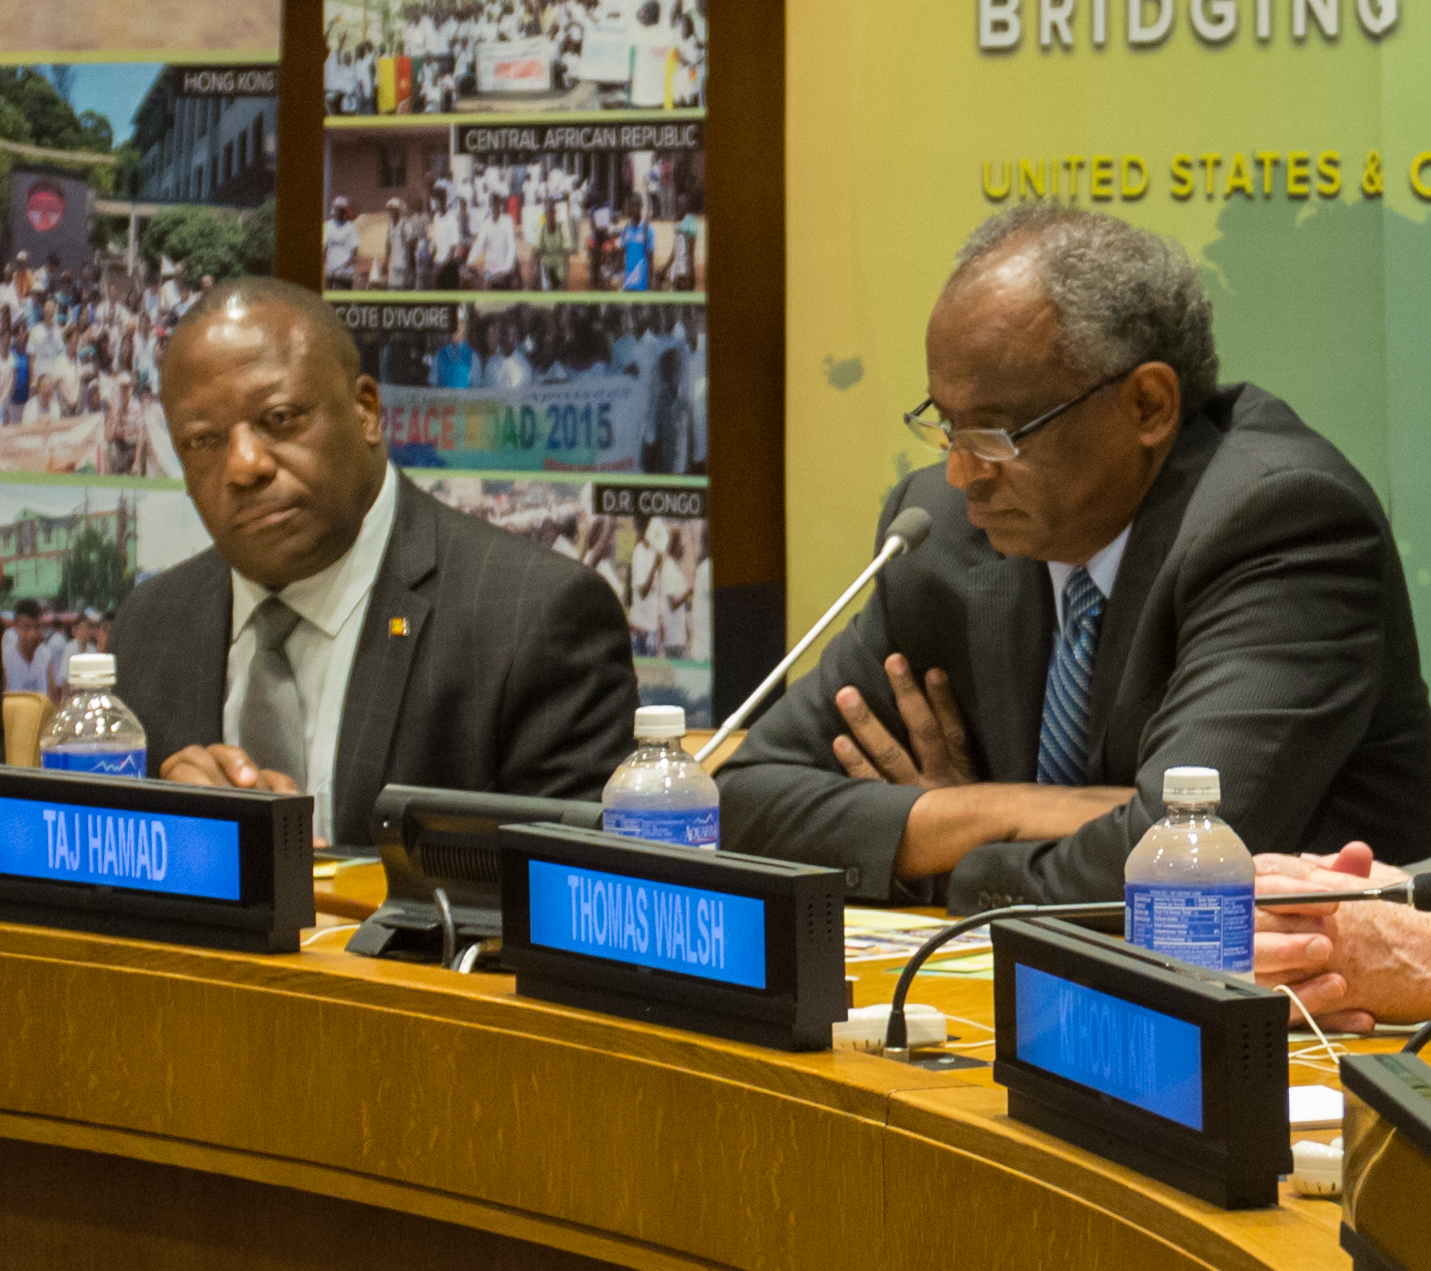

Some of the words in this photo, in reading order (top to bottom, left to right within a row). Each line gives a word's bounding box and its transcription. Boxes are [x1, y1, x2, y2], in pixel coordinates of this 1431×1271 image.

[184, 71, 235, 93] HONG
[238, 70, 274, 91] KONG
[465, 130, 538, 151] CENTRAL
[545, 127, 618, 149] AFRICAN
[621, 124, 695, 147] REPUBLIC
[981, 152, 1149, 199] UNITED
[1170, 149, 1341, 198] STATES
[1360, 150, 1384, 195] &
[383, 306, 450, 328] D'IVOIRE
[545, 402, 613, 451] 2015
[602, 491, 634, 513] D.R.
[639, 490, 701, 515] CONGO
[43, 809, 81, 871] TAJ
[88, 814, 167, 881] HAMAD
[568, 875, 649, 954] THOMAS
[653, 890, 725, 969] WALSH
